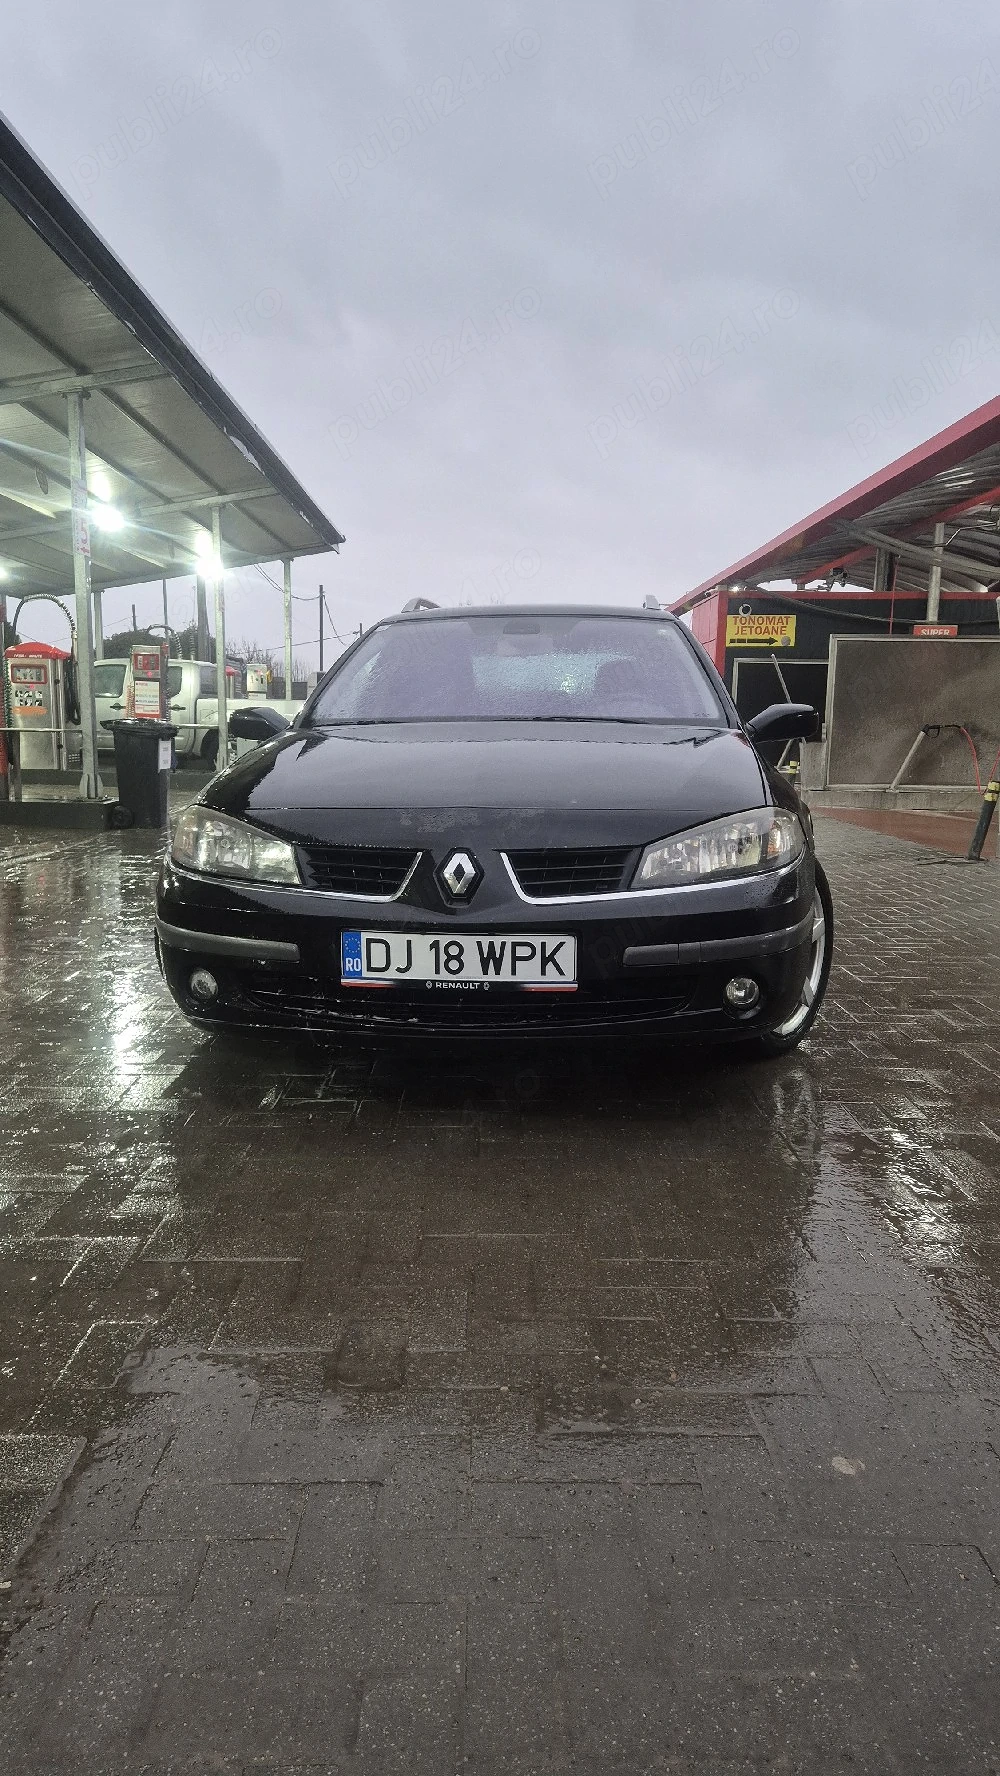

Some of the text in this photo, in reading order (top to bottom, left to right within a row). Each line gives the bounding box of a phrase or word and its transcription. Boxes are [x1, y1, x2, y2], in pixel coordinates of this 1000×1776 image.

[733, 615, 791, 626] TONOMAT
[734, 625, 787, 636] JETOANE
[921, 628, 950, 636] SUPER
[365, 937, 412, 974] DJ
[429, 939, 465, 975] 18
[475, 940, 566, 976] WPK
[345, 957, 361, 972] RO
[436, 981, 480, 990] RENAULT
